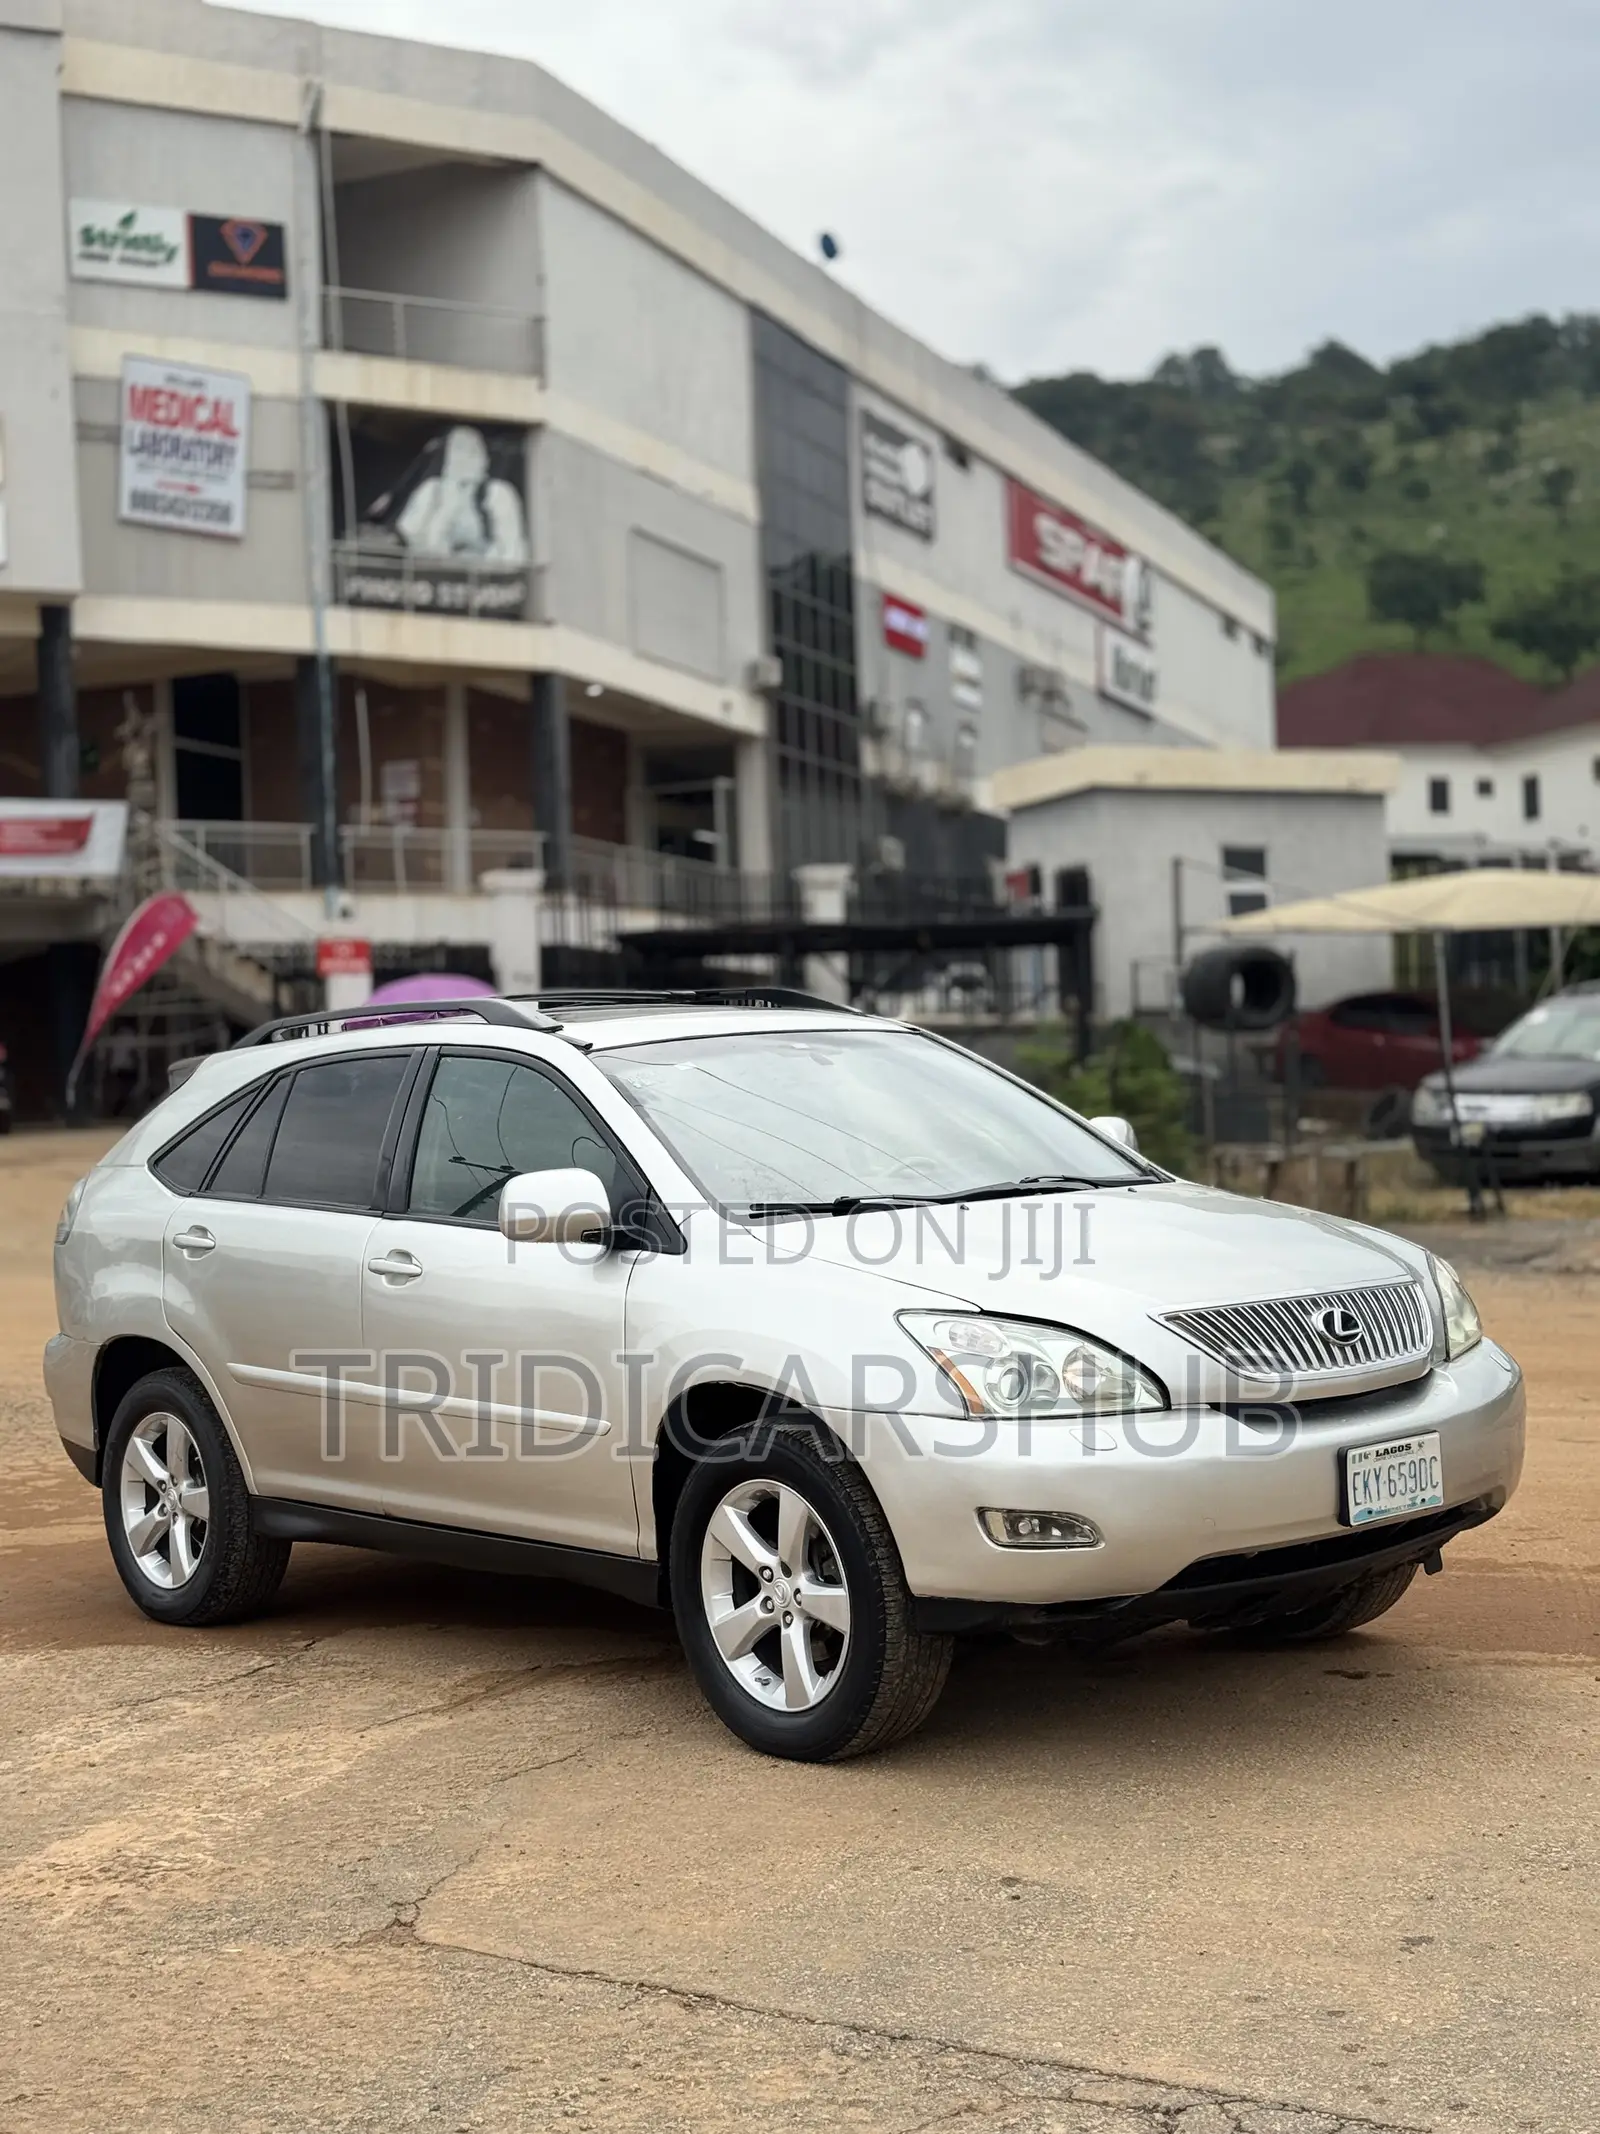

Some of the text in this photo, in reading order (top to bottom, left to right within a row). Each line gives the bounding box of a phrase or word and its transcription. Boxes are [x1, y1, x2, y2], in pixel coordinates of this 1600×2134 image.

[129, 383, 240, 438] MEDICAL
[128, 424, 237, 472] LABORATORY
[1374, 1442, 1413, 1458] LAGOS
